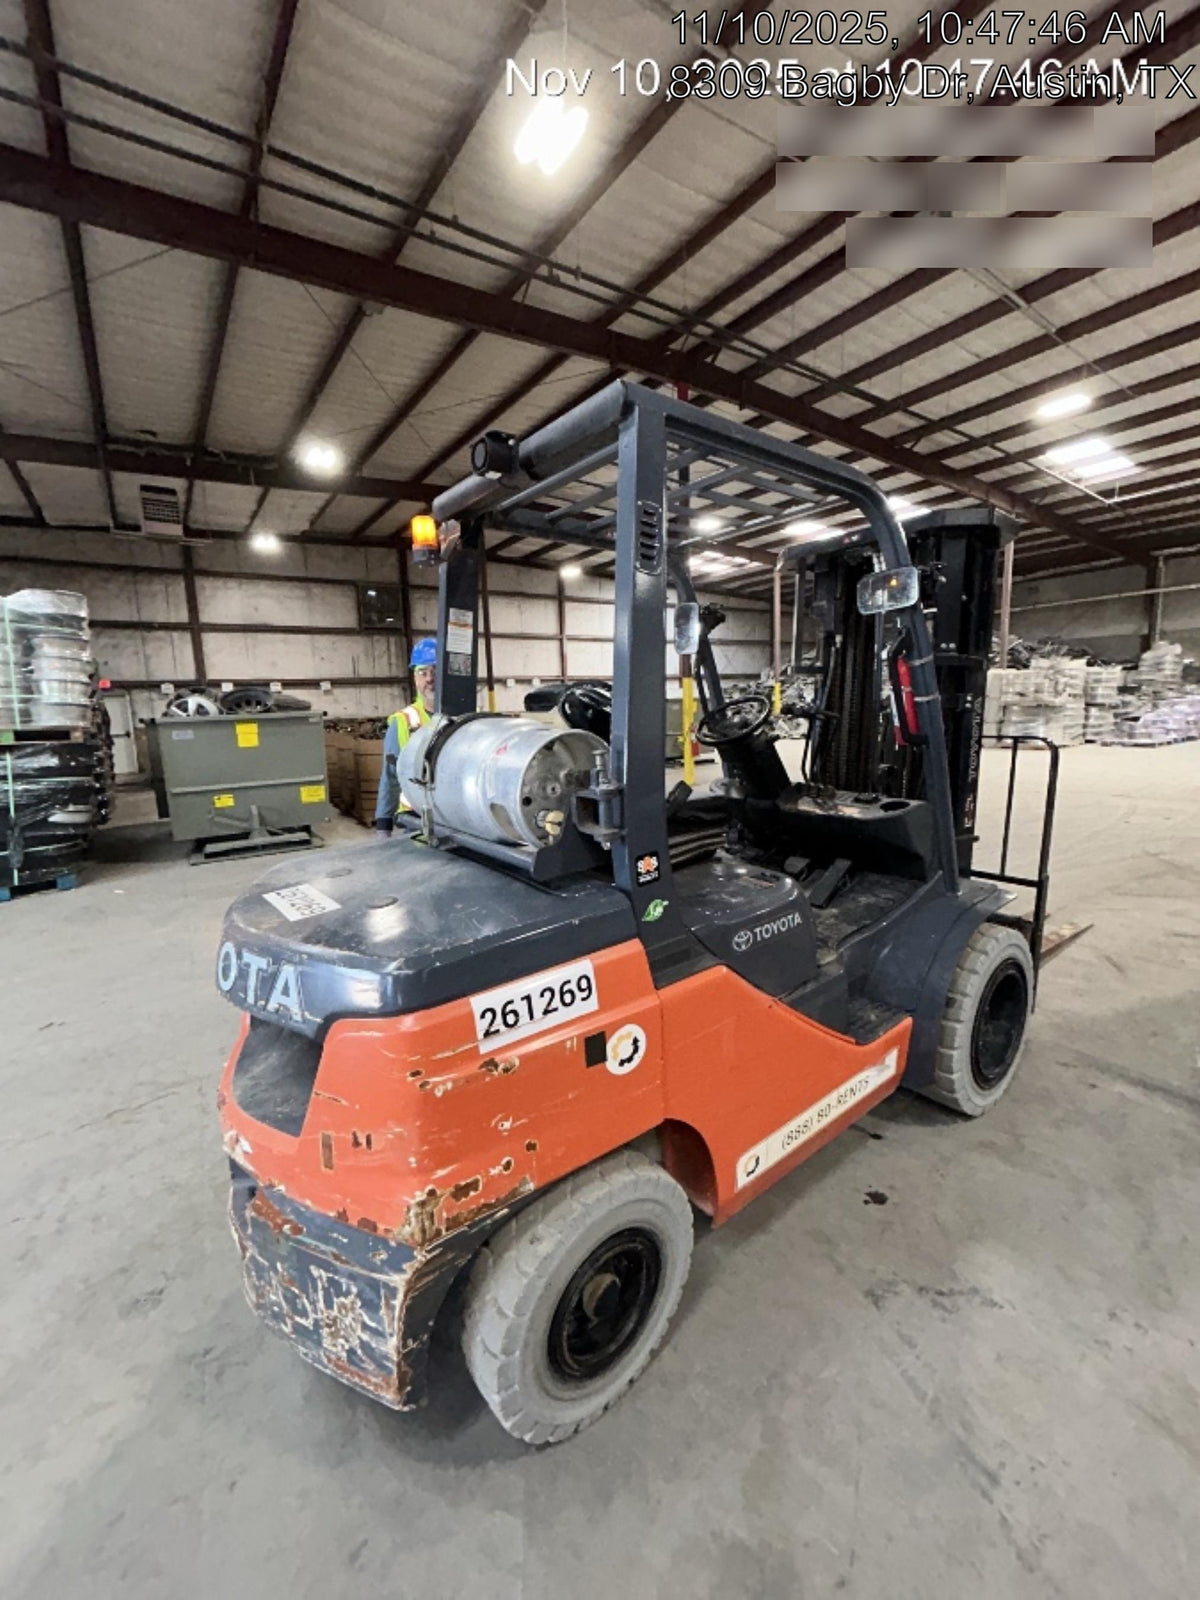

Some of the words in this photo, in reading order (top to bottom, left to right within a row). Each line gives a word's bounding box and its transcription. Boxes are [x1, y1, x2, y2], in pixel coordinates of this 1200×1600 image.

[753, 912, 802, 941] TOYOTA
[480, 974, 592, 1039] 261269
[781, 1116, 814, 1150] (888)
